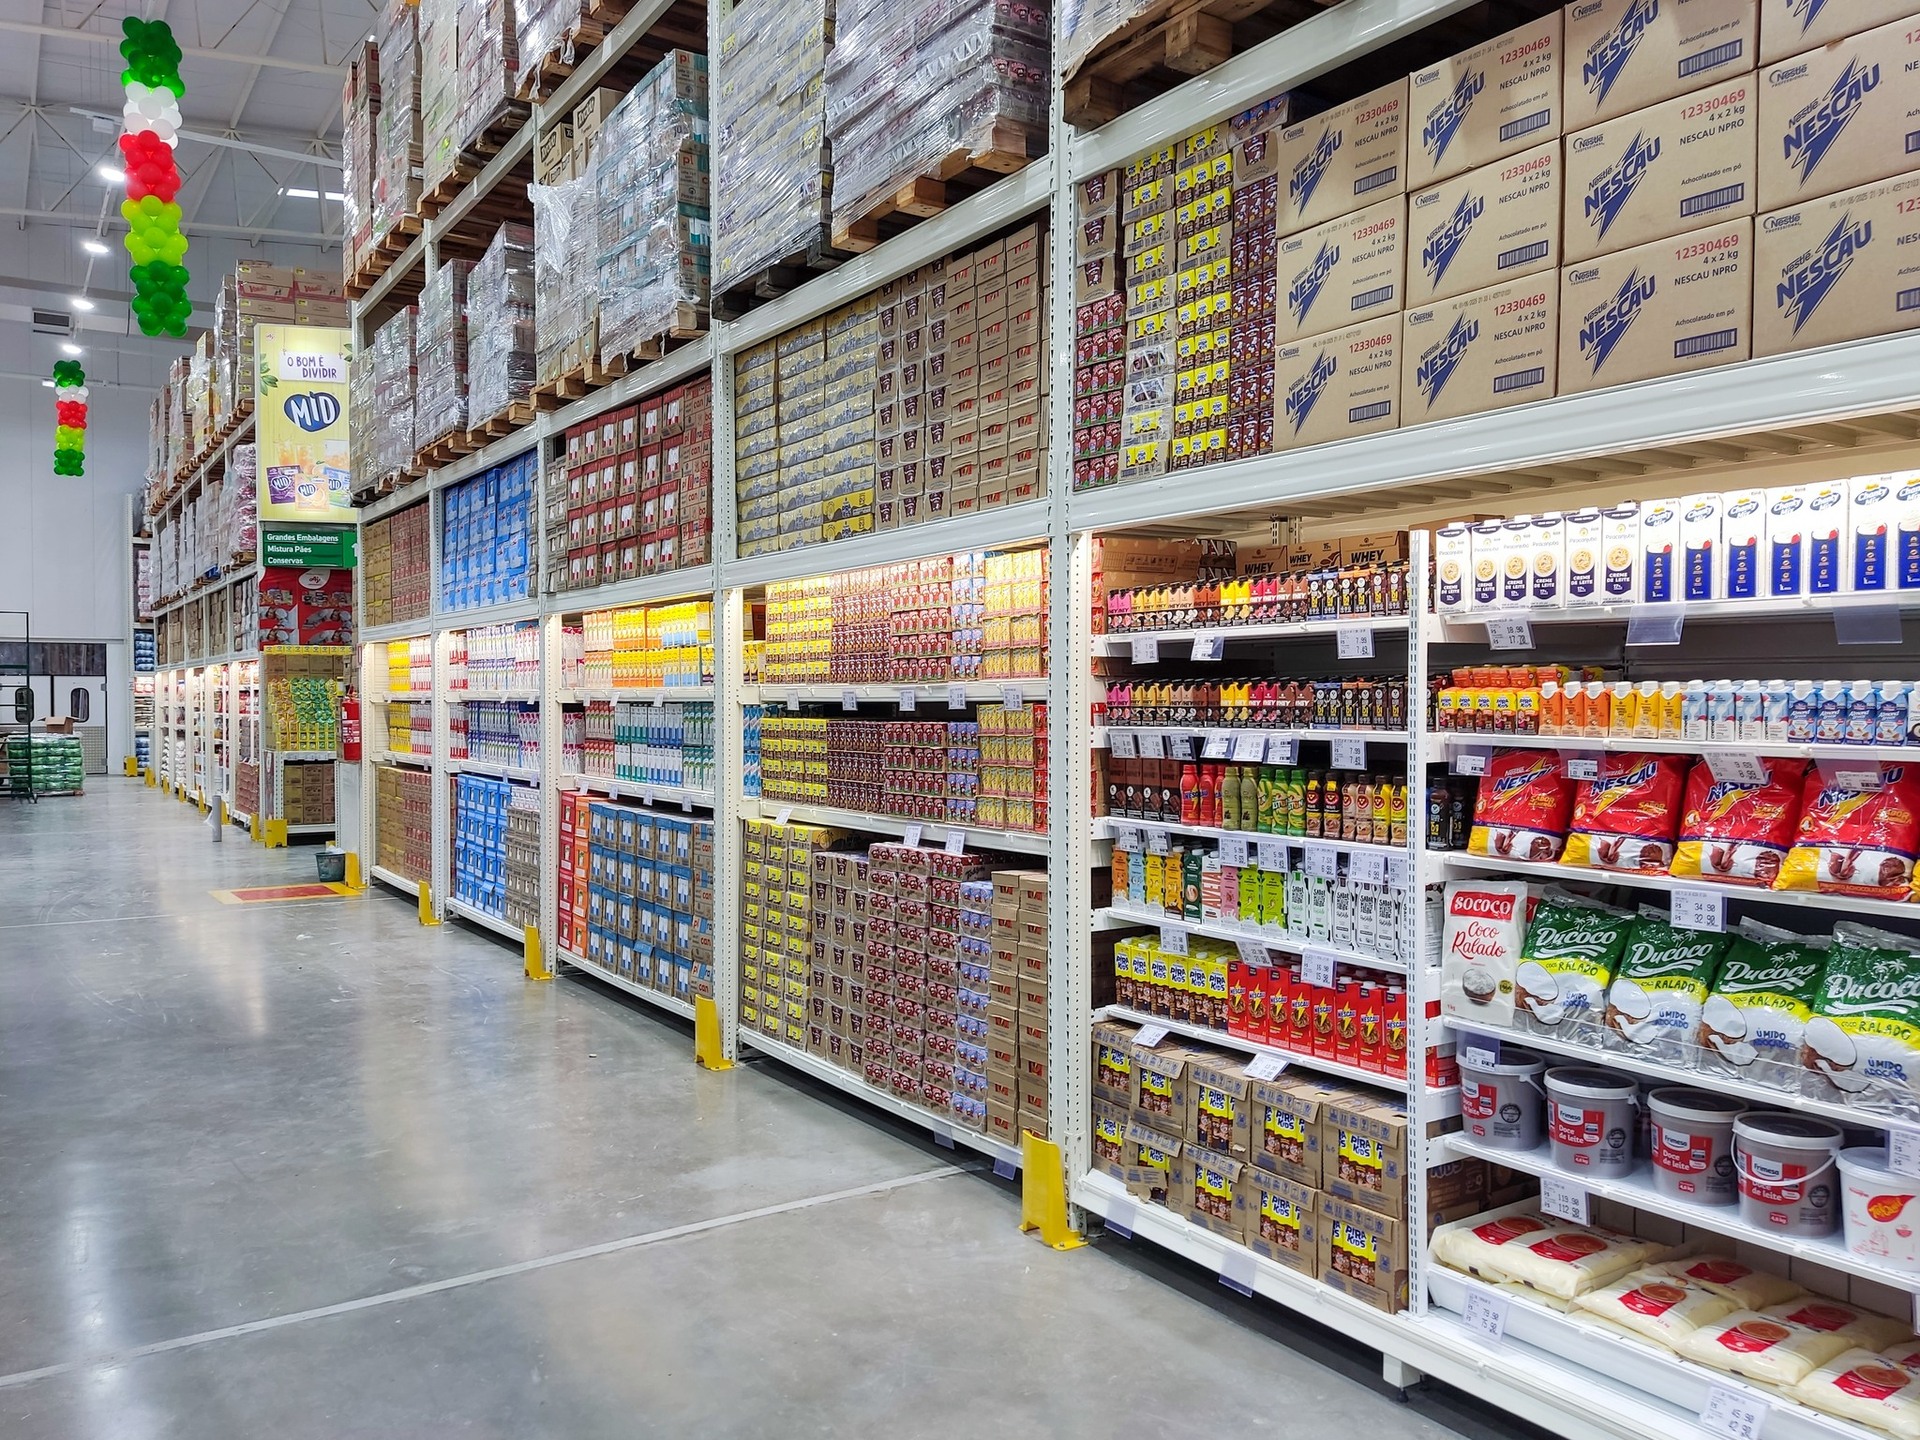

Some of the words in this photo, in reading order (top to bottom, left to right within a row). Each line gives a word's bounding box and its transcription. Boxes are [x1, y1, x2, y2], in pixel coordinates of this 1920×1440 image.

[1679, 28, 1718, 46] Achocolatado
[1720, 25, 1730, 33] em
[1731, 19, 1740, 29] pó
[1500, 36, 1550, 64] 12330469
[1583, 0, 1659, 85] NESCAU
[1500, 74, 1528, 90] NESCAU
[1531, 65, 1550, 78] NPRO
[1355, 100, 1398, 125] 12330469
[1423, 71, 1485, 148] NESCAU
[1500, 98, 1531, 114] Achocolatado
[1541, 92, 1548, 100] pó
[1680, 89, 1745, 120] 12330469
[1783, 63, 1880, 160] NESCAU
[1709, 113, 1714, 121] 4
[1725, 109, 1731, 117] 2
[1733, 105, 1745, 115] kg
[1355, 132, 1379, 148] NESCAU
[1381, 126, 1398, 137] NPRO
[1680, 128, 1715, 145] NESCAU
[1718, 119, 1744, 133] NPRO
[1290, 130, 1342, 198] NESCAU
[1501, 155, 1551, 181] 12330469
[1584, 136, 1660, 218] NESCAU
[1681, 170, 1720, 186] Achocolatado
[1733, 164, 1741, 173] pó
[1499, 189, 1527, 204] NESCAU
[1529, 181, 1549, 194] NPRO
[1353, 218, 1395, 241] 12330469
[1423, 196, 1484, 269] NESCAU
[1352, 252, 1376, 263] NESCAU
[1378, 245, 1394, 255] NPRO
[1675, 235, 1739, 261] 12330469
[1720, 253, 1725, 261] 2
[1728, 250, 1738, 260] kg
[1776, 220, 1872, 308] NESCAU
[1289, 245, 1340, 309] NESCAU
[1674, 273, 1710, 285] NESCAU
[1712, 264, 1737, 277] NPRO
[1494, 294, 1545, 316] 12330469
[1537, 310, 1546, 319] kg
[1579, 275, 1655, 351] NESCAU
[1675, 314, 1714, 327] Achocolatado
[1727, 308, 1735, 317] pó
[1494, 328, 1523, 341] NESCAU
[1525, 322, 1545, 333] NPRO
[1349, 334, 1392, 353] 12330469
[1417, 319, 1479, 387] NESCAU
[288, 357, 293, 366] O
[296, 356, 315, 366] BOM
[1495, 353, 1526, 365] Achocolatado
[1536, 349, 1542, 357] pó
[302, 368, 337, 378] DIVIDIR
[1349, 365, 1373, 376] NESCAU
[1374, 360, 1392, 370] NPRO
[1286, 356, 1336, 416] NESCAU
[297, 534, 338, 542] Embalagens
[1290, 554, 1312, 563] WHEY
[1351, 550, 1384, 563] WHEY
[1245, 563, 1273, 573] WHEY
[1592, 762, 1658, 795] NESCAU
[1695, 903, 1715, 912] 34.90
[1468, 922, 1499, 938] Coco
[1536, 928, 1617, 947] Ducoco
[1452, 931, 1506, 960] Ralado
[1632, 944, 1713, 964] Ducoco
[1558, 961, 1598, 975] RALADO
[1725, 961, 1816, 981] Ducoco
[1209, 975, 1226, 986] PIRA
[1655, 980, 1695, 993] RALADO
[1748, 997, 1795, 1011] RALADO
[1659, 1008, 1686, 1020] ÚMIDO
[1756, 1027, 1786, 1040] ÚMIDO
[1858, 1022, 1911, 1040] RALADO
[1868, 1057, 1902, 1072] ÚMIDO
[1558, 1126, 1575, 1135] Doce
[1568, 1135, 1584, 1144] leite
[1351, 1135, 1370, 1148] PIRA
[1663, 1150, 1680, 1160] Doce
[1672, 1160, 1690, 1171] leite
[1762, 1190, 1782, 1201] leite
[1346, 1225, 1366, 1238] PIRA
